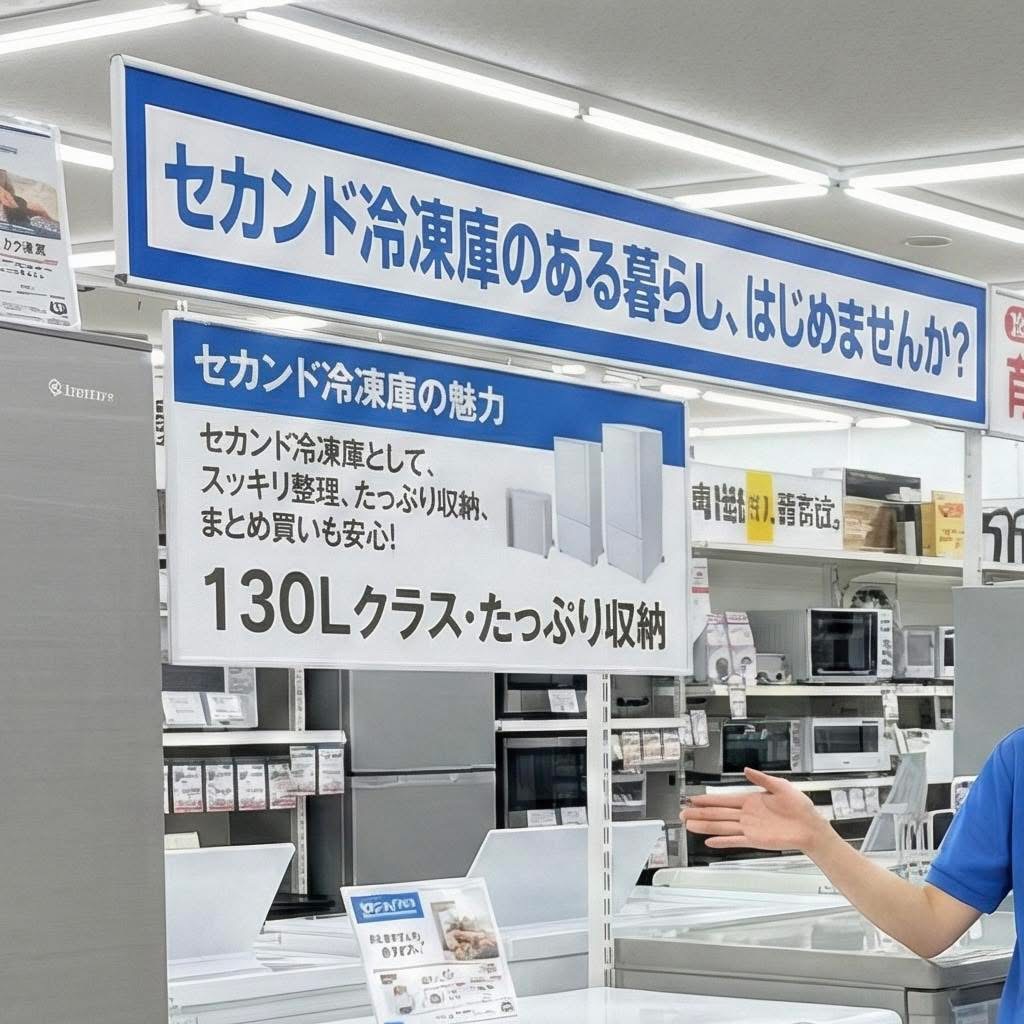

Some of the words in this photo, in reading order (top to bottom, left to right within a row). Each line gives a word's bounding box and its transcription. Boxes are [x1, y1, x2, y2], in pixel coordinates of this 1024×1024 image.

[166, 144, 970, 378] セカンド冷凍庫のある暮らし、はじめませんか?
[194, 343, 504, 425] セカンド冷凍庫の魅力
[200, 423, 434, 477] セカンド冷凍庫として、
[201, 466, 488, 521] スッキリ整理、たっぷり収納、
[201, 507, 396, 551] まとめ買いも安心!
[205, 568, 666, 650] 130Lクラス・たっぷり収納
